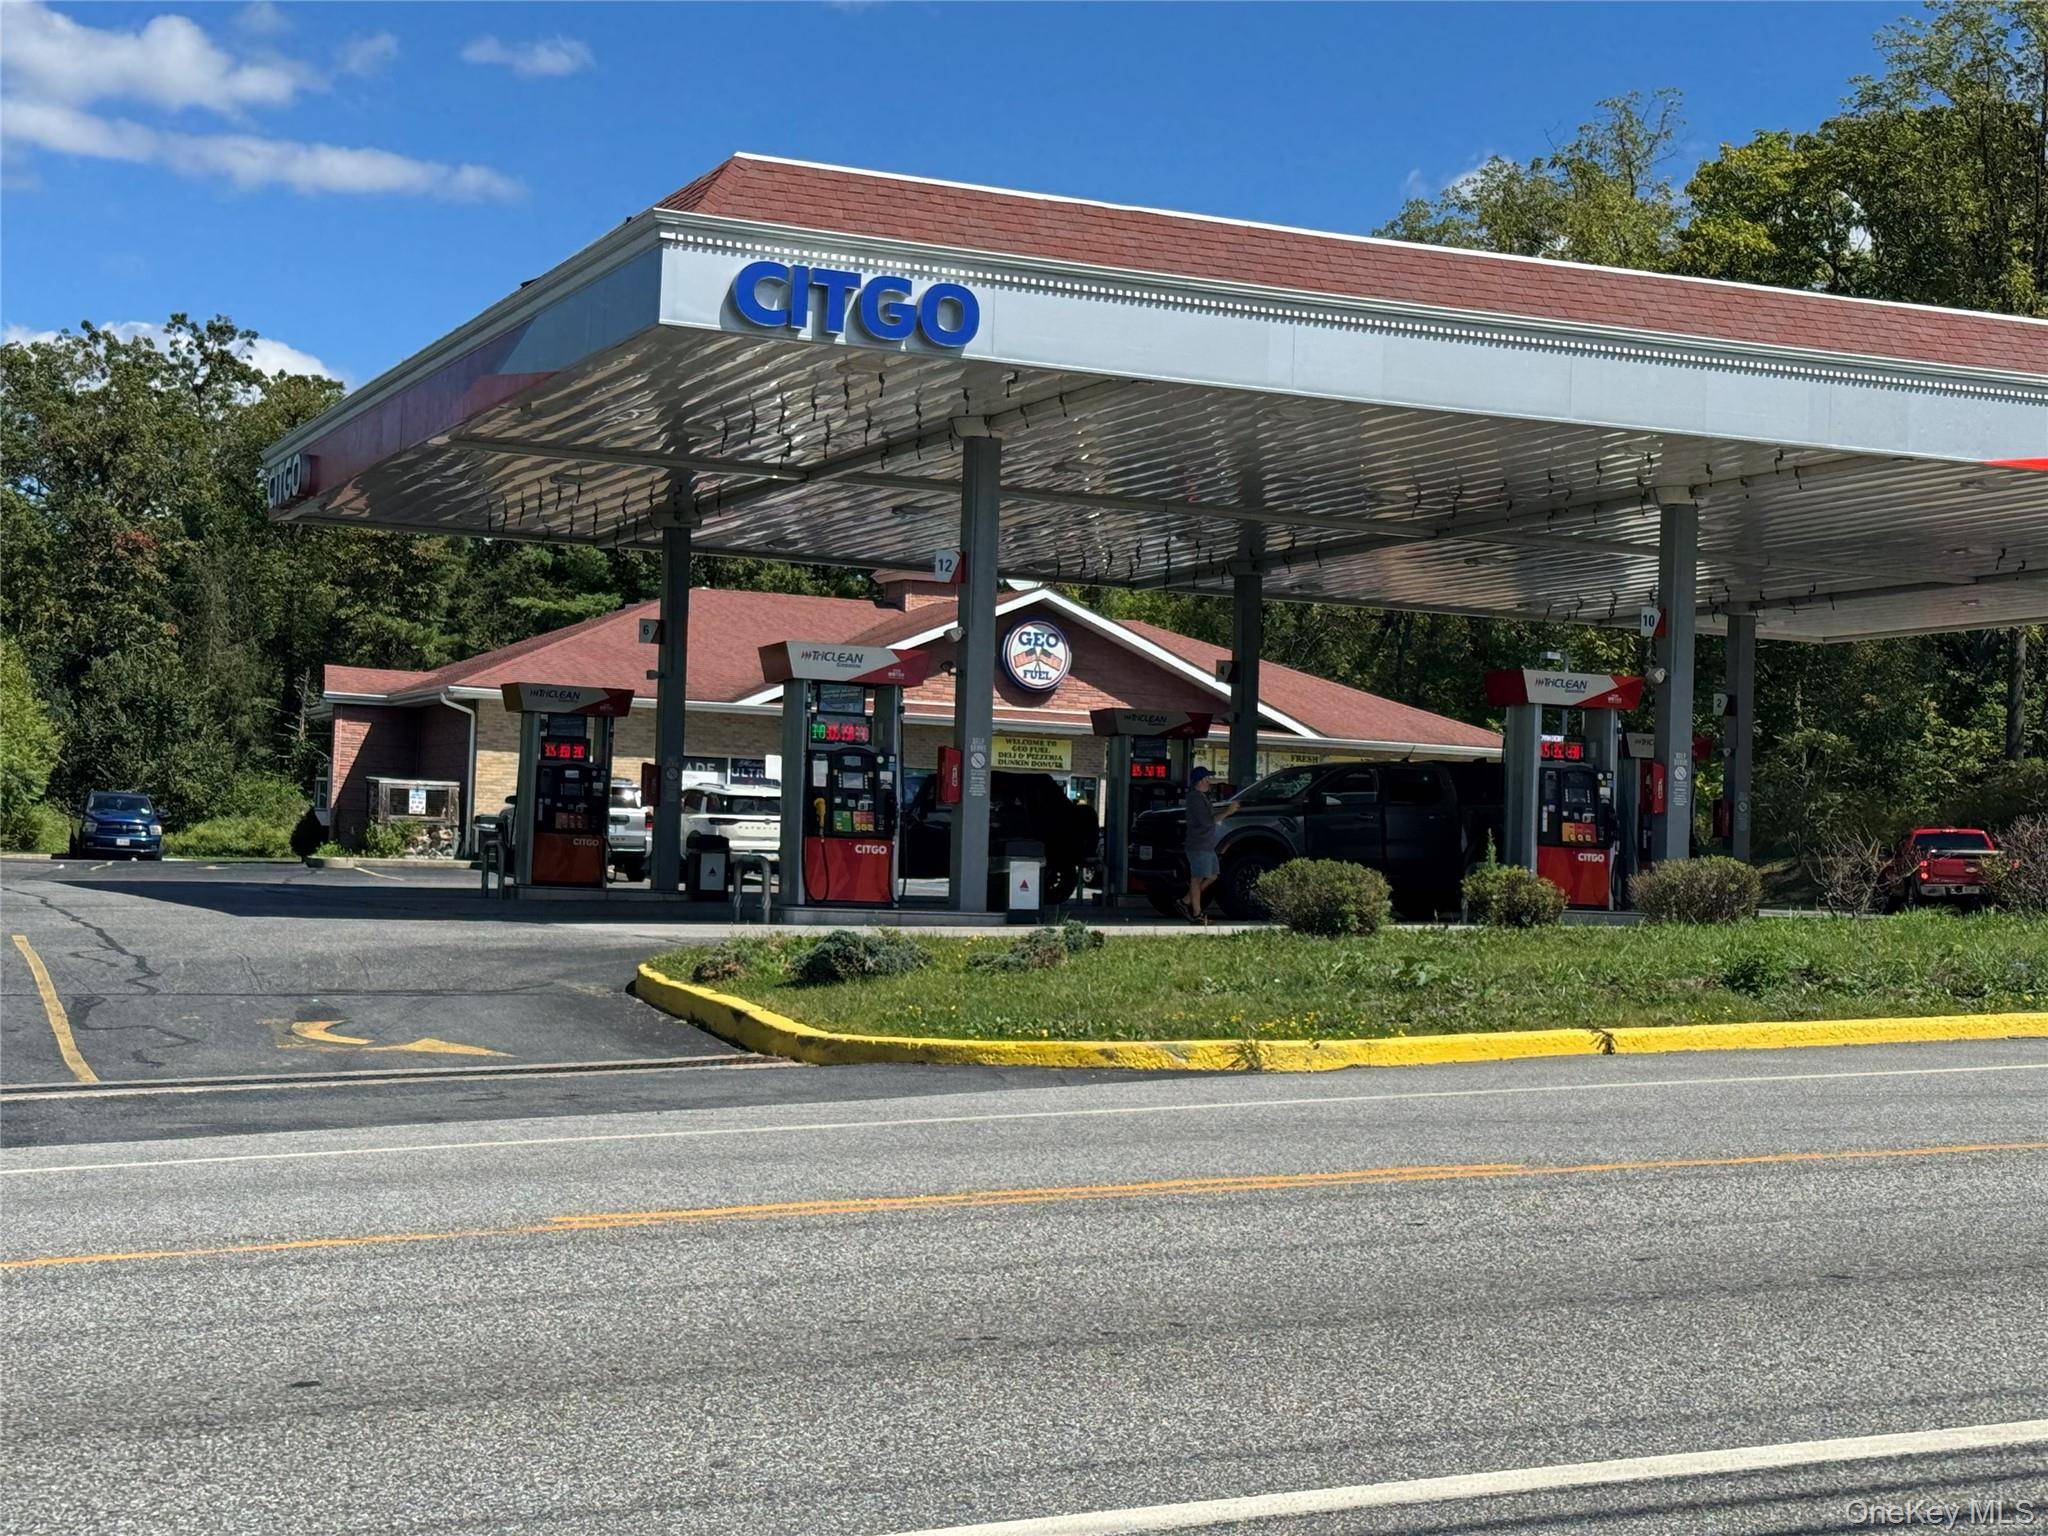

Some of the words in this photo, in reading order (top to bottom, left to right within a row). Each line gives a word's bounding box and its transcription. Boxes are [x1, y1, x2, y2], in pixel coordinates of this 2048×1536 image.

[735, 260, 980, 347] CITGO
[938, 558, 953, 573] 12
[1643, 614, 1655, 627] 10
[643, 624, 650, 635] 6
[1018, 631, 1060, 648] GEO
[812, 650, 864, 664] TriCLEAN
[1023, 669, 1052, 680] FUEL
[1005, 738, 1046, 746] WELCOME
[1029, 746, 1051, 754] FUEL
[1026, 753, 1064, 761] PIZZERIA
[1291, 754, 1319, 762] FRESH
[685, 761, 716, 772] ADE
[997, 759, 1030, 767] DUNKIN
[731, 767, 764, 778] ULTR
[572, 838, 600, 847] CITGO
[855, 844, 887, 854] CITGO
[1578, 853, 1605, 863] CITGO
